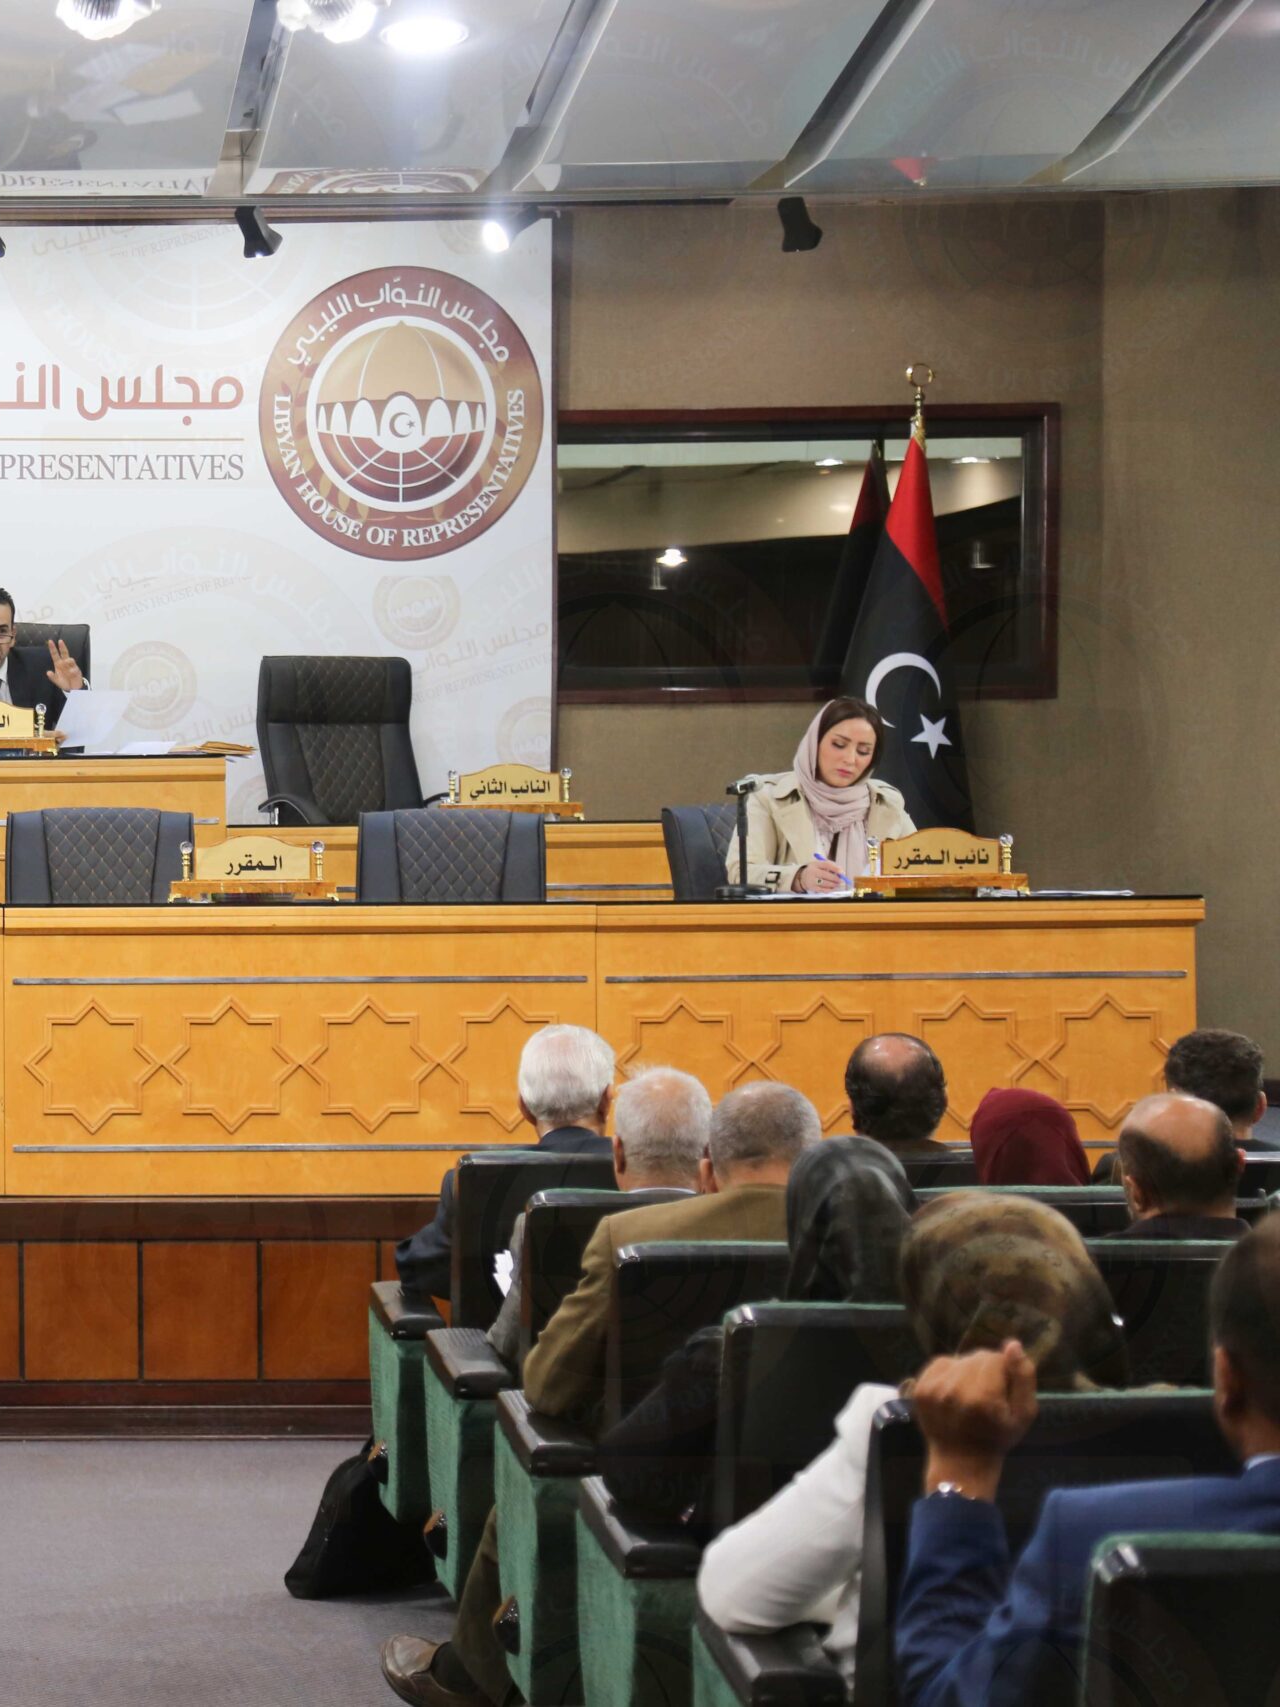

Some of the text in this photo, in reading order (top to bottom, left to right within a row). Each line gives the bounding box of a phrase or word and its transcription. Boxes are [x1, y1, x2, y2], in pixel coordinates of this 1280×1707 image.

[287, 293, 353, 366] الليبي
[440, 299, 510, 363] مجلس
[76, 363, 245, 426] مجلس
[274, 389, 525, 547] LIBYAN HOUSE OF REPRESENTATIVES
[510, 779, 551, 799] النائب
[225, 853, 283, 876] المقرر
[893, 847, 990, 870] نائب المقرر
